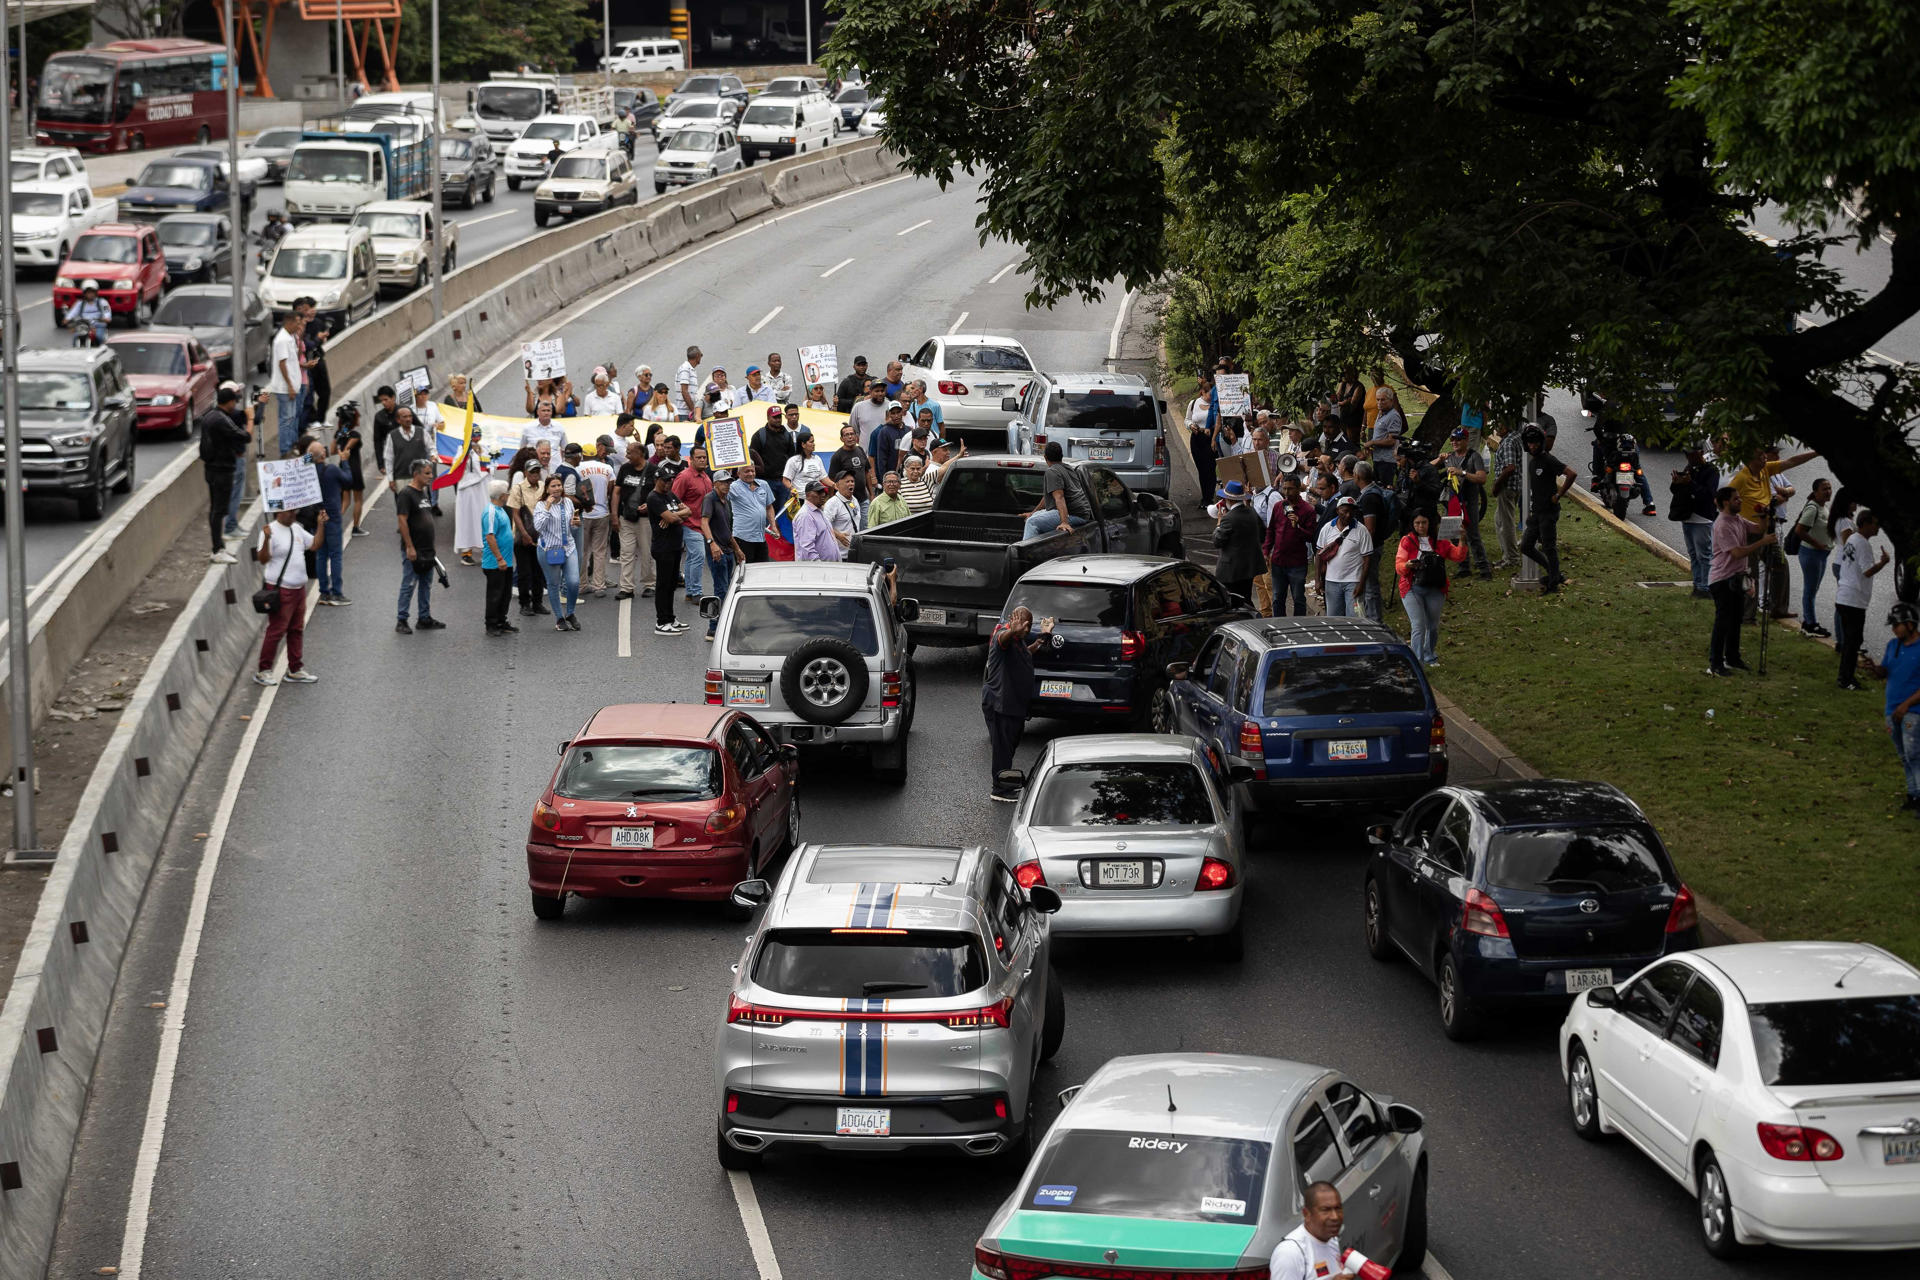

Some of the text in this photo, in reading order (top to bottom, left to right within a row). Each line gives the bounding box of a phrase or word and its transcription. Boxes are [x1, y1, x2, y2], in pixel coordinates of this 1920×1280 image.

[581, 467, 609, 477] PATINES
[731, 689, 764, 699] AF435GV
[1331, 743, 1365, 755] AF146SV
[616, 831, 650, 843] AHD 08K
[1103, 867, 1140, 879] MDT 73R
[1571, 974, 1589, 987] IAR
[1128, 1137, 1188, 1154] Ridery
[1039, 1189, 1074, 1197] Zupper
[1204, 1200, 1242, 1211] Ridery
